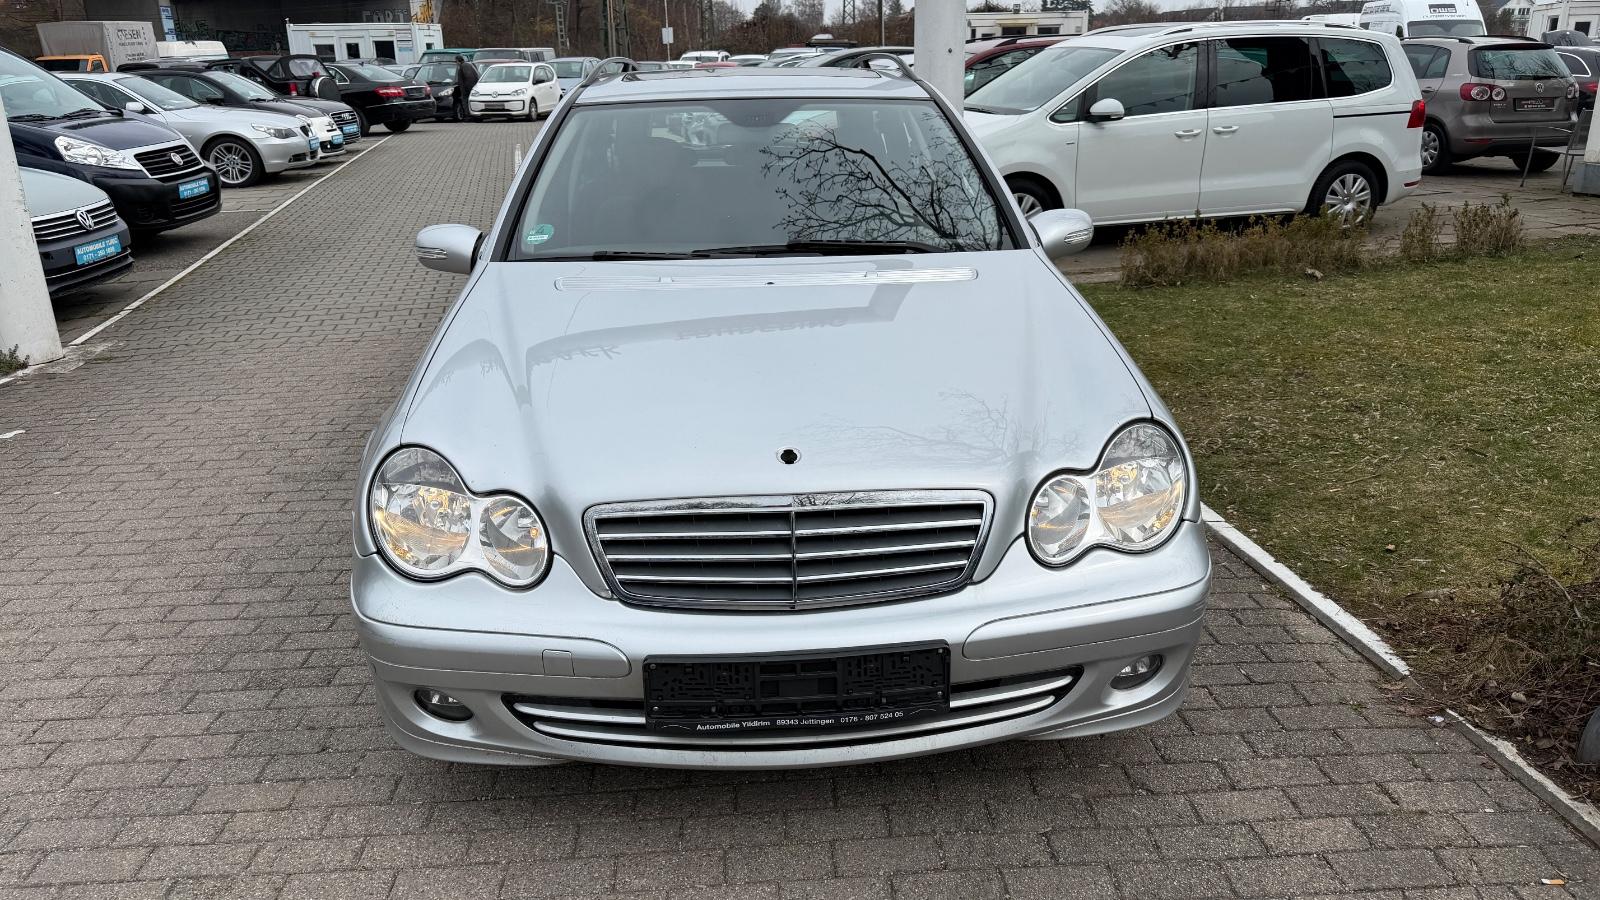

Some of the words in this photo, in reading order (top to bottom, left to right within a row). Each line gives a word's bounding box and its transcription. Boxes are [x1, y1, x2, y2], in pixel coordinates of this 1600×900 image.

[77, 241, 105, 255] AUTOMOBILE
[696, 722, 741, 731] Automobile
[800, 718, 835, 726] Jettingen
